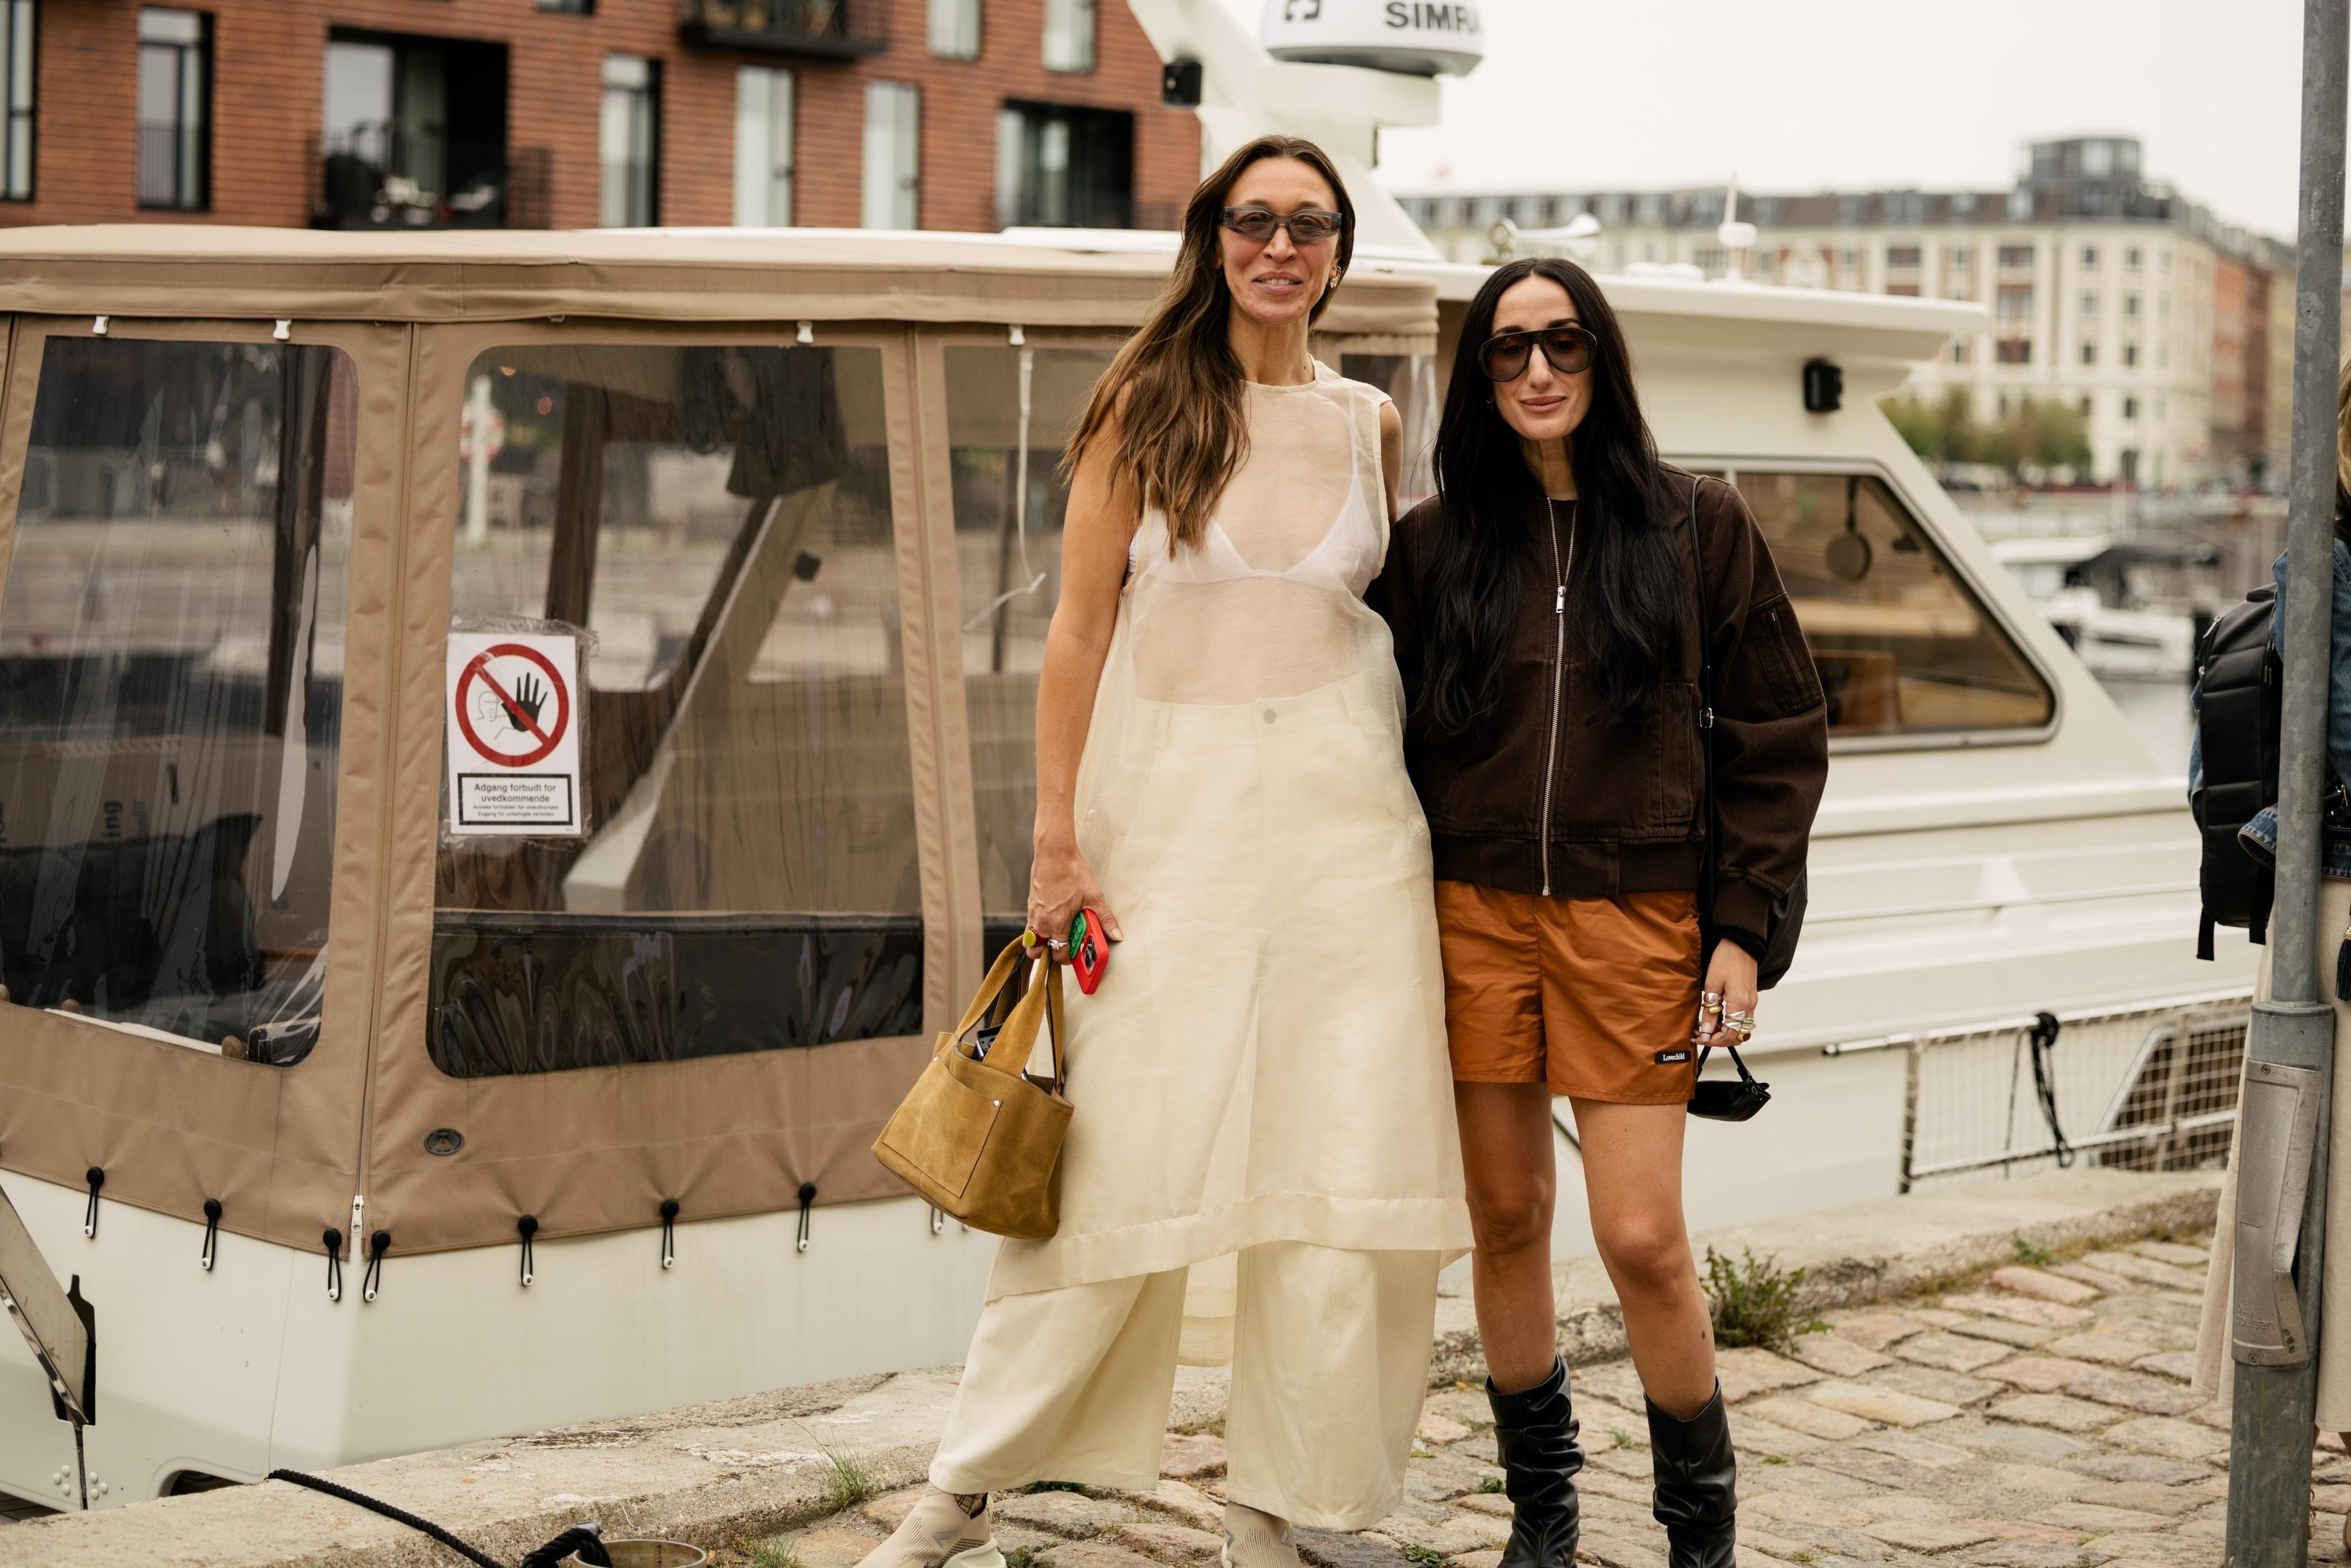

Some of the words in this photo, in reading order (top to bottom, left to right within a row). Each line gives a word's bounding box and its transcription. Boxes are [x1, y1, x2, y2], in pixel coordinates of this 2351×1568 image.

[474, 783, 508, 793] Adgang
[102, 800, 123, 838] ing
[1663, 1053, 1685, 1061] Lovechild
